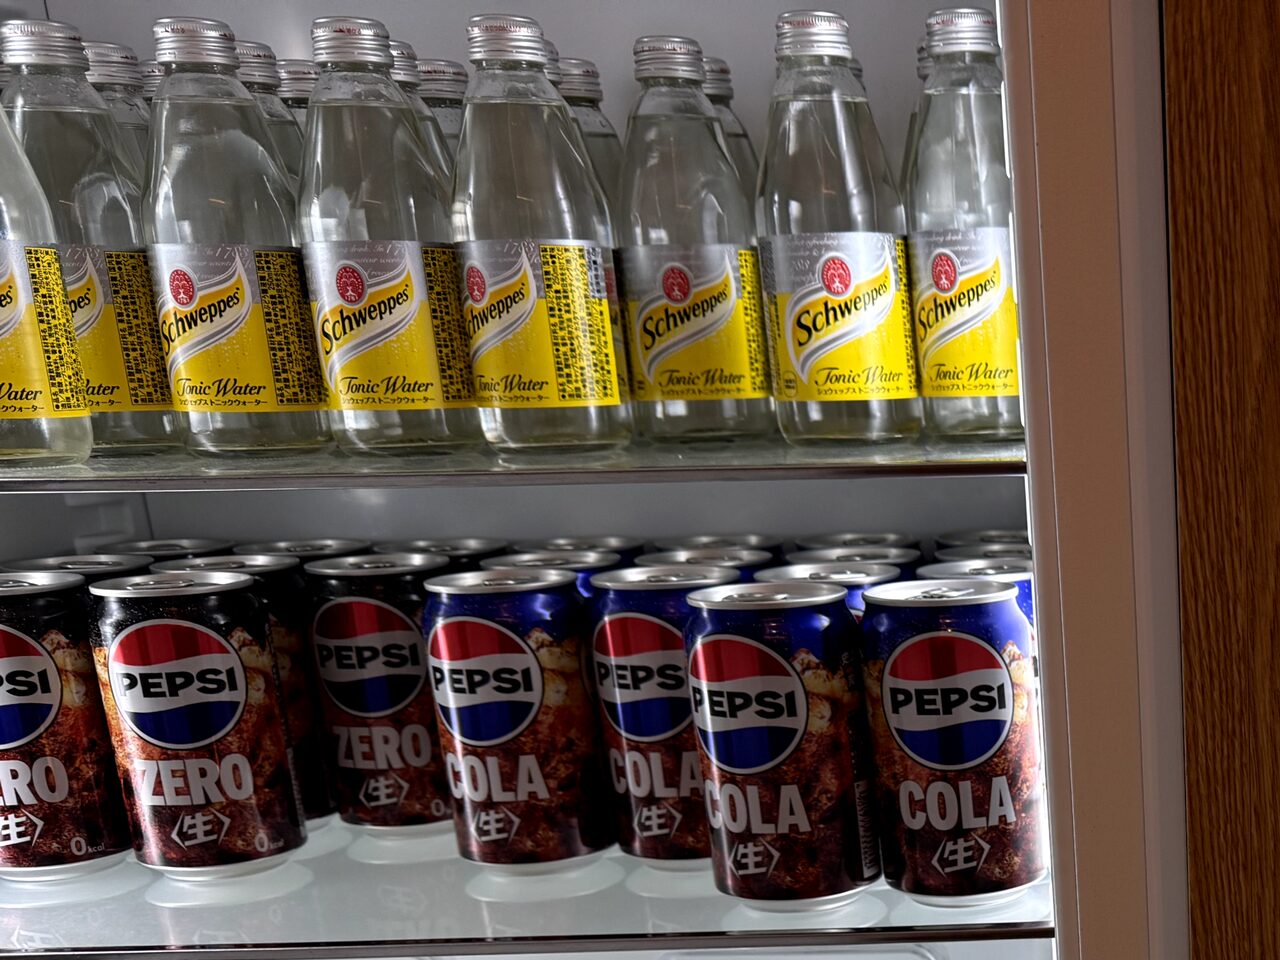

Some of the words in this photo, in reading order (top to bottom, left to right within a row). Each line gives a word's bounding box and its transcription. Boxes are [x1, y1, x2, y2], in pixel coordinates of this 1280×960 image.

[160, 289, 240, 357] Schweppes
[321, 288, 410, 356] Schweppes
[466, 286, 525, 341] chweppes
[642, 288, 728, 350] Schweppes
[795, 279, 888, 347] Schweppes
[917, 275, 997, 342] Schweppes
[86, 379, 120, 396] ater
[176, 378, 211, 396] Tonic
[212, 378, 267, 397] Water
[340, 376, 379, 396] Tonic
[380, 375, 434, 396] Water
[501, 374, 549, 393] Water
[658, 369, 700, 388] Tonic
[700, 368, 745, 386] Water
[812, 366, 861, 386] Tonic
[861, 365, 903, 385] Water
[929, 363, 964, 382] Tonic
[965, 362, 1014, 382] Water
[316, 643, 420, 670] PEPSI
[596, 662, 685, 690] PEPS
[116, 667, 238, 698] PEPSI
[432, 666, 533, 694] PEPSI
[889, 683, 1007, 716] PEPSI
[692, 686, 798, 719] PEPSI
[333, 724, 432, 770] ZERO
[0, 757, 69, 806] RO
[134, 753, 254, 806] ZERO
[446, 752, 550, 802] COLA
[609, 748, 704, 798] COLA
[704, 779, 811, 834] COLA
[900, 775, 1017, 831] COLA
